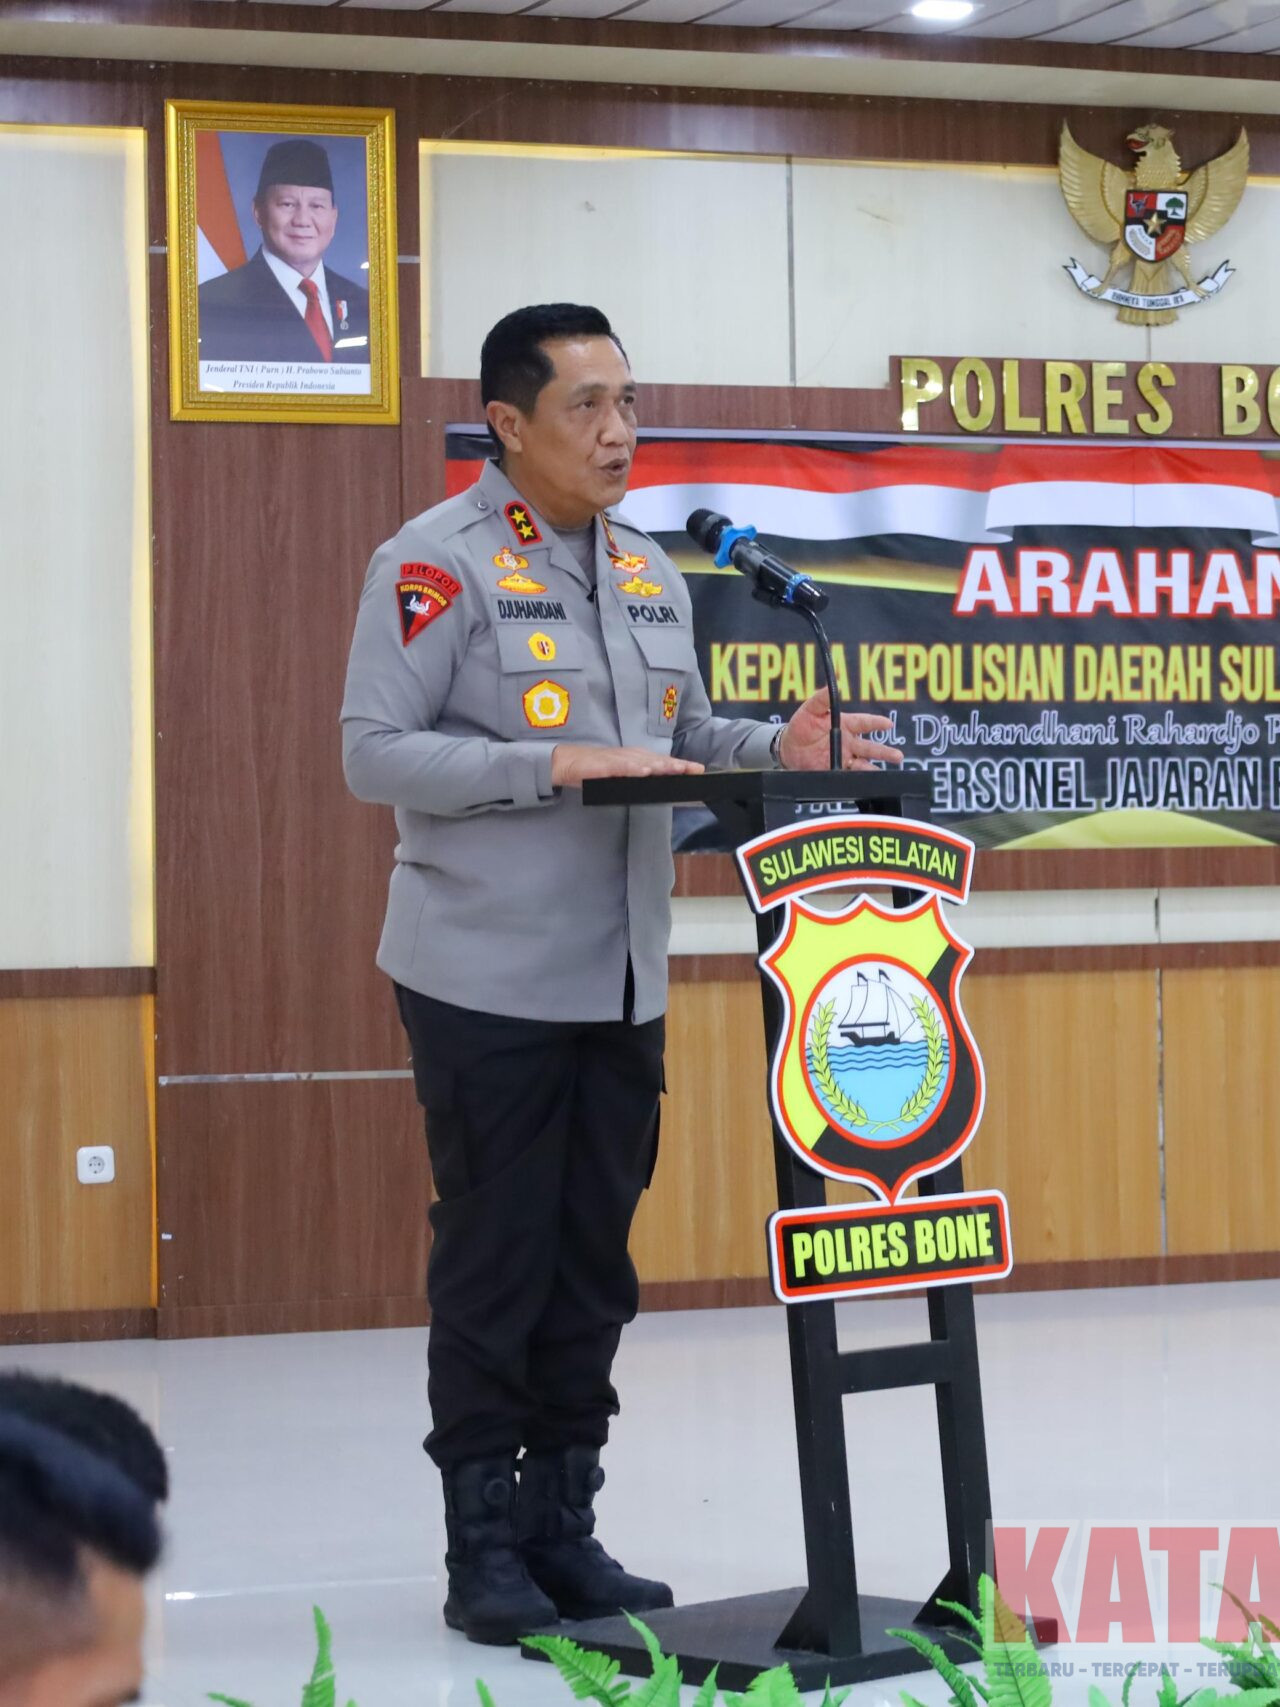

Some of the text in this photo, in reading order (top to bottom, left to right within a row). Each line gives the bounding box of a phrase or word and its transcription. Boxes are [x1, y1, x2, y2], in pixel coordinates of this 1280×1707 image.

[232, 380, 336, 391] Presiden Republik Indonesia
[239, 365, 255, 374] TNI
[296, 366, 329, 375] Prabowo
[901, 356, 1176, 436] POLRES
[402, 563, 461, 596] PELOPOR
[497, 599, 567, 620] DJUHANDANI
[627, 605, 680, 624] POLRI
[860, 643, 1064, 702] KEPOLISIAN
[1073, 644, 1210, 702] DAERAH
[859, 710, 907, 746] ol.
[912, 709, 1117, 756] Djuhandhani
[1123, 709, 1260, 755] Rahardjo
[1102, 756, 1261, 812] JAJARAN
[759, 835, 958, 886] SULAWESI SELATAN
[792, 1212, 994, 1278] POLRES BONE
